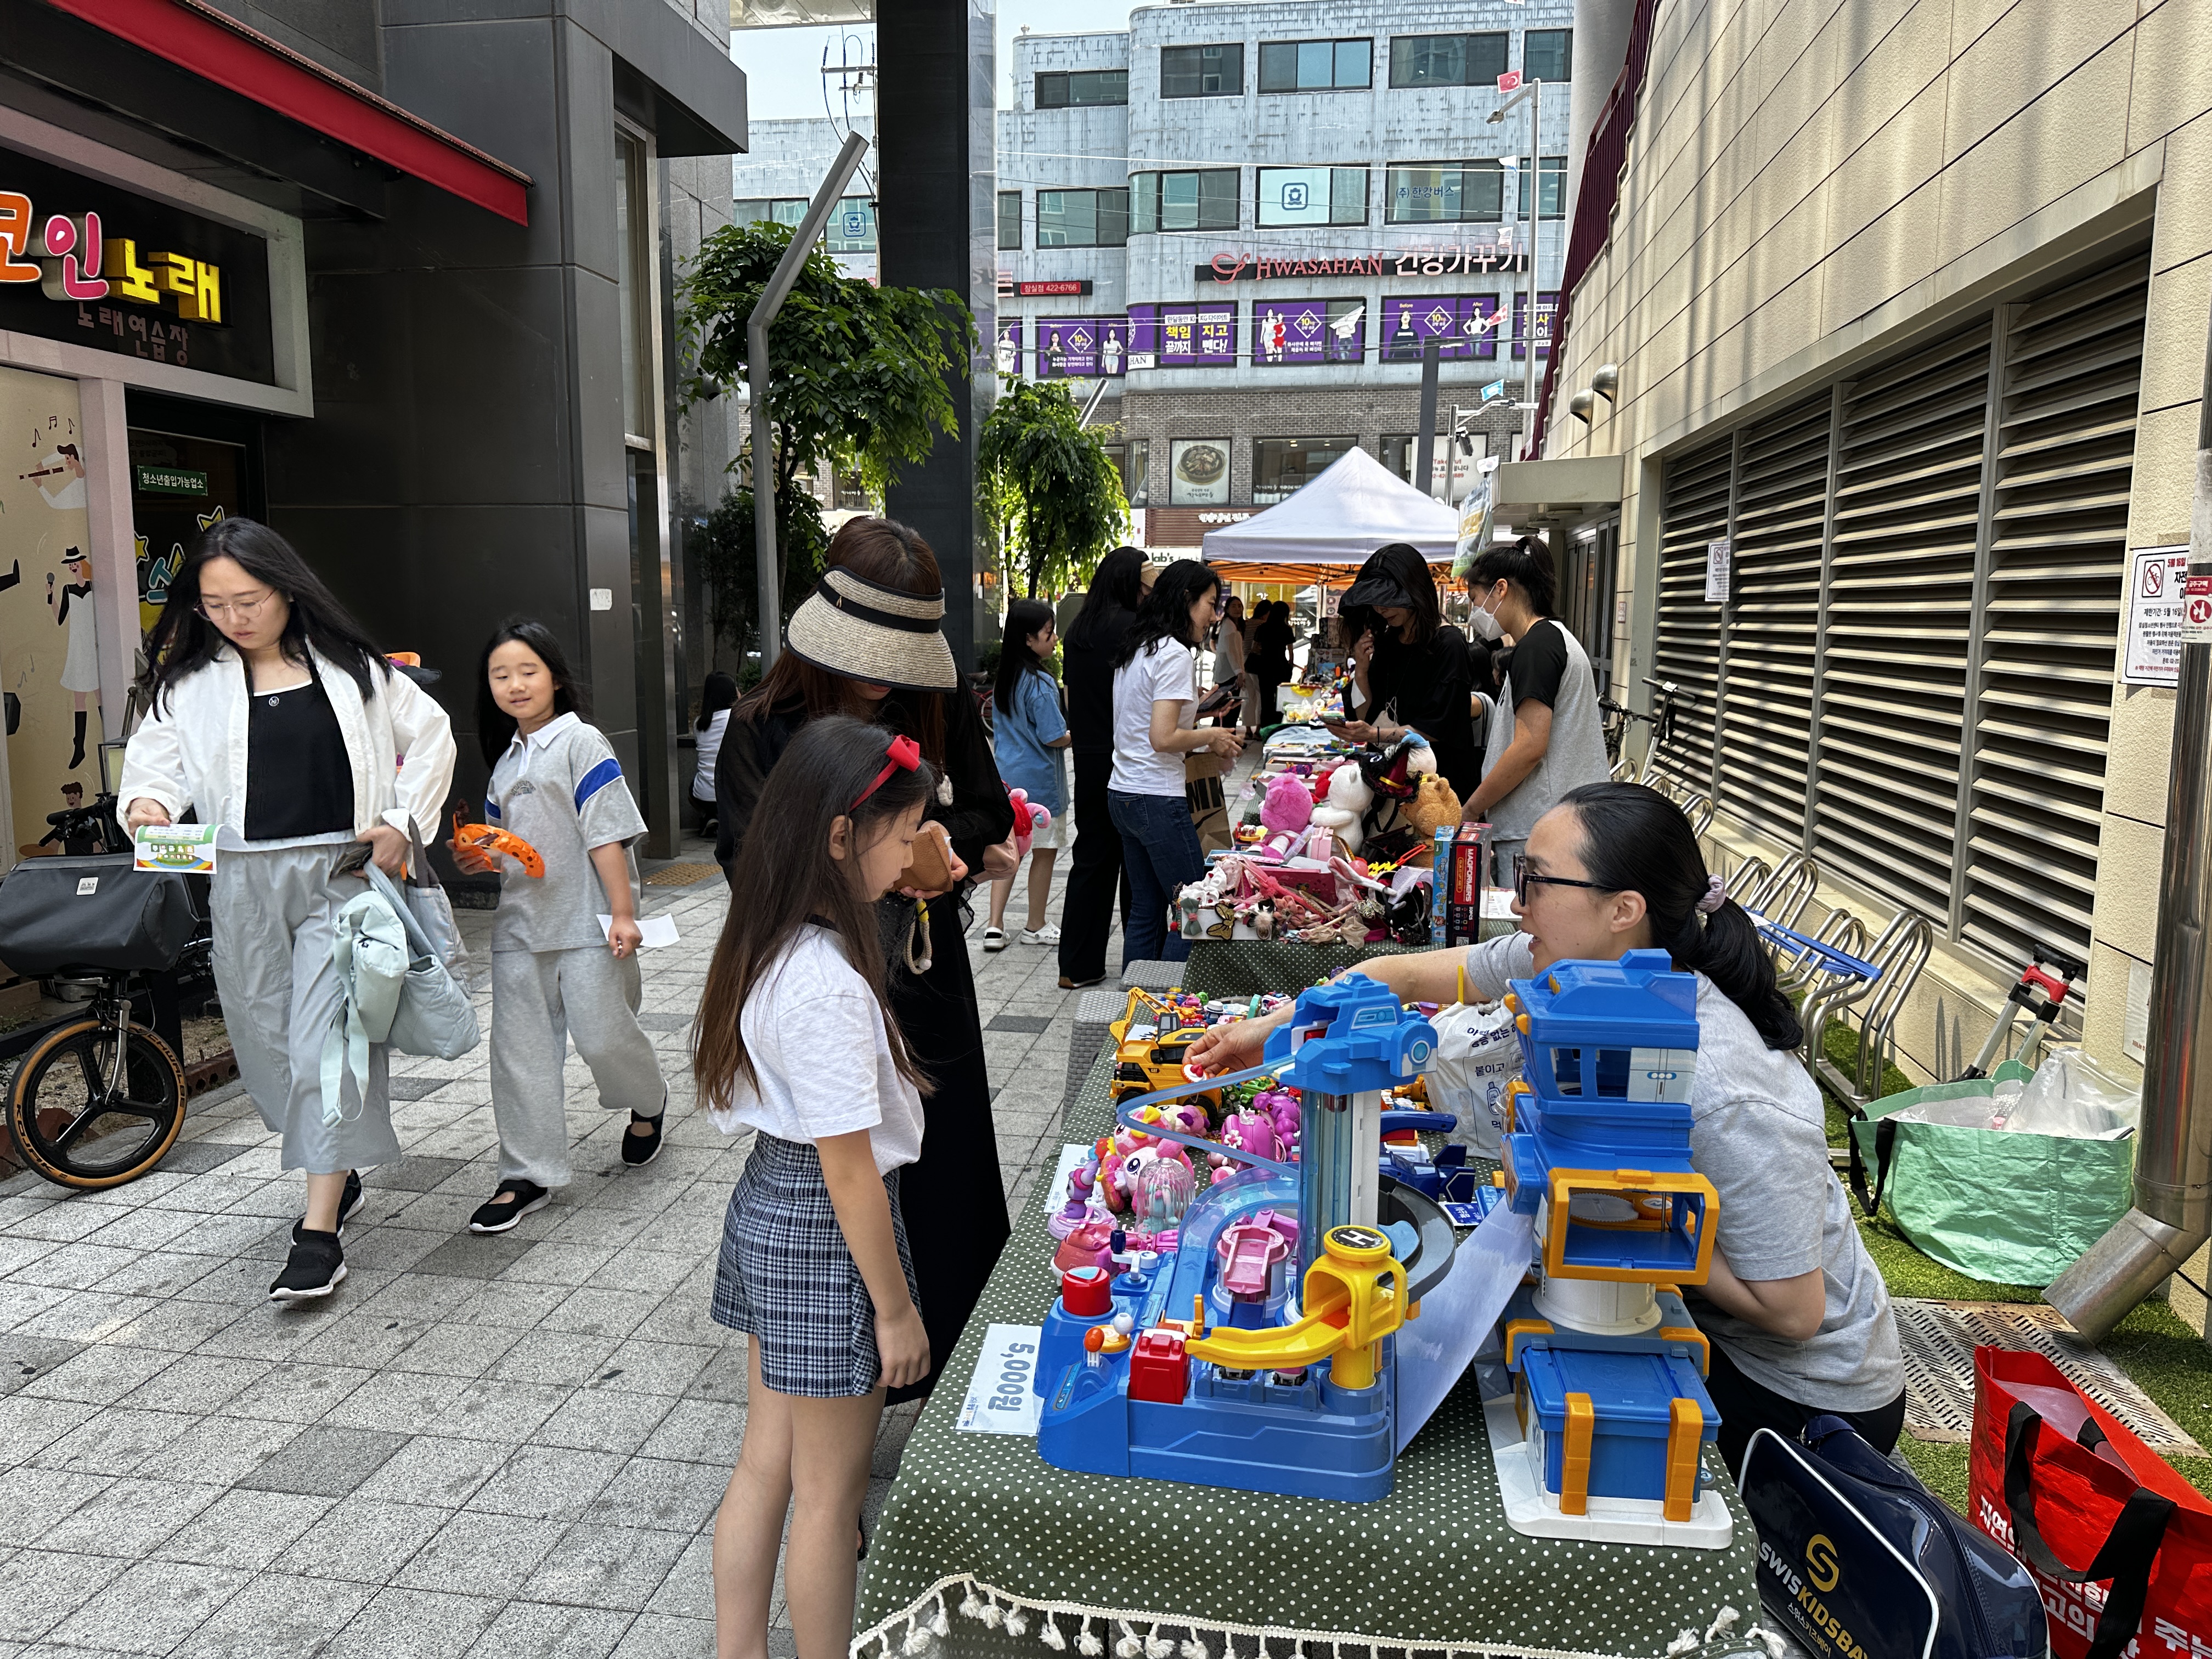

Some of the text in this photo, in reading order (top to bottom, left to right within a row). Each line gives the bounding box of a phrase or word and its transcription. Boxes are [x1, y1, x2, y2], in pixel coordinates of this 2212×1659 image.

[1412, 186, 1454, 198] 한강버스
[1255, 252, 1384, 280] HWASAHAN
[77, 302, 188, 366] 노래연습장
[1165, 325, 1191, 339] 책임
[1202, 324, 1228, 337] 지고
[1165, 340, 1191, 354] 끝까지
[142, 472, 204, 489] 청소년출입가능업소
[1152, 552, 1174, 562] lab's
[2163, 607, 2171, 617] 5월
[1465, 848, 1474, 902] MAGFORMERS
[1490, 1028, 1510, 1041] 없는
[1475, 1063, 1504, 1077] 붙이고
[988, 1342, 1035, 1412] 5,000원
[1759, 1542, 1869, 1659] SWISKIDSBA
[1787, 1602, 1831, 1658] 스위스키즈베이
